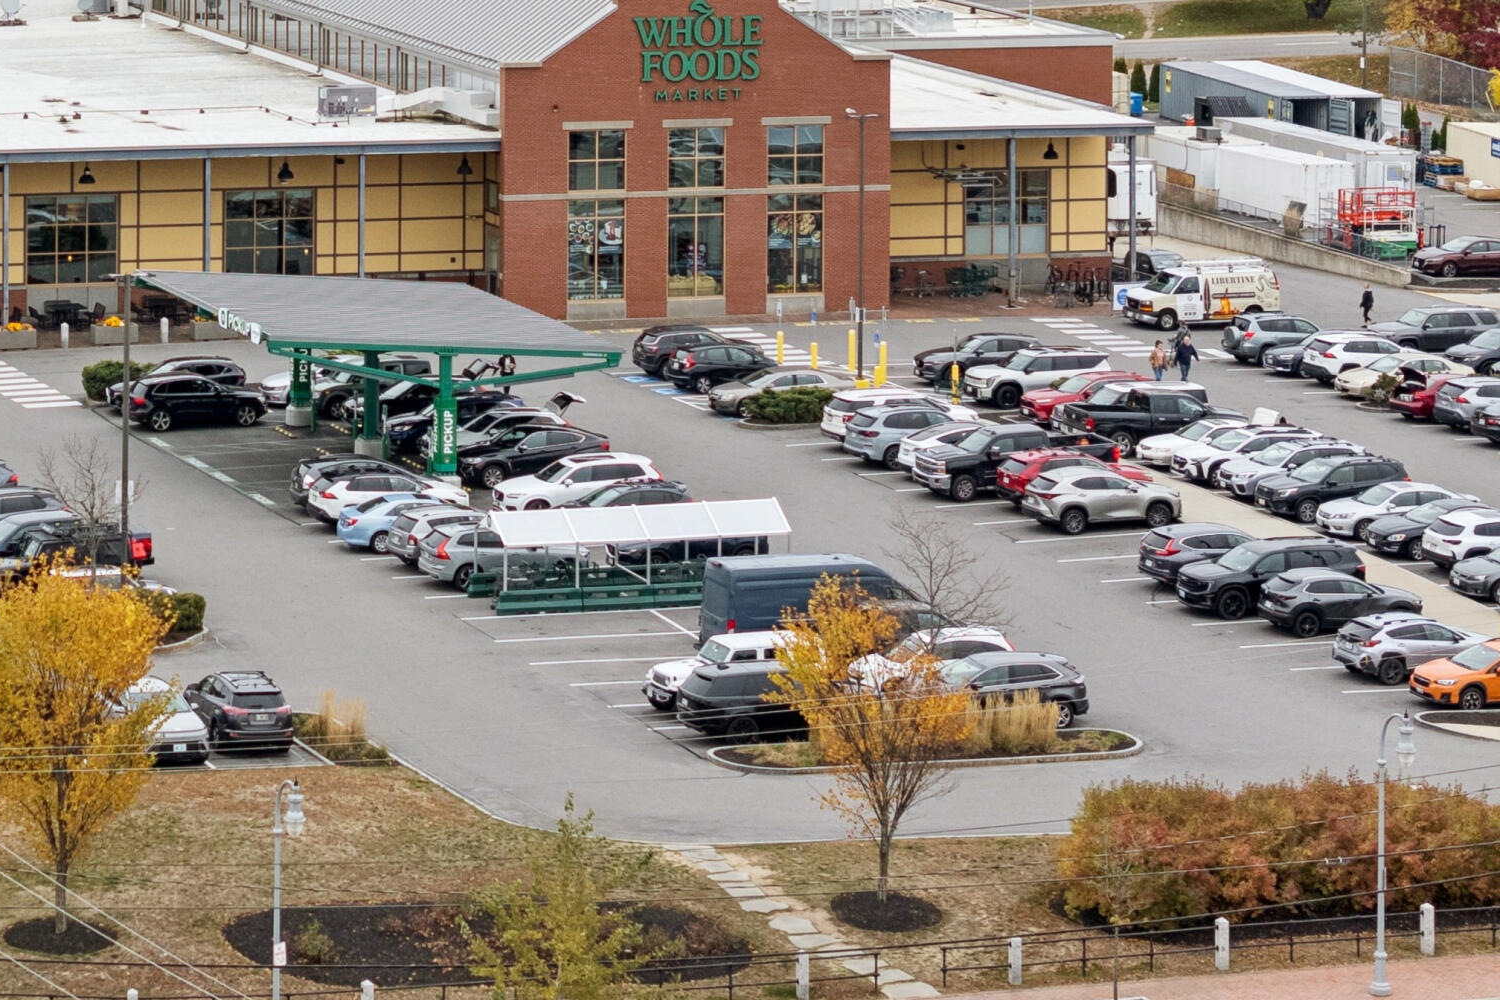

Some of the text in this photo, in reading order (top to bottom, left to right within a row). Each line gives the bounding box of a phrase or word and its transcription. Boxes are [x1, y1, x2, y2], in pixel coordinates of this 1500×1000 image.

[633, 14, 764, 48] WHOLE
[641, 49, 760, 82] FOODS
[655, 87, 743, 102] MARKET
[1211, 275, 1257, 285] LIBERTINE
[443, 410, 454, 455] PICKUP
